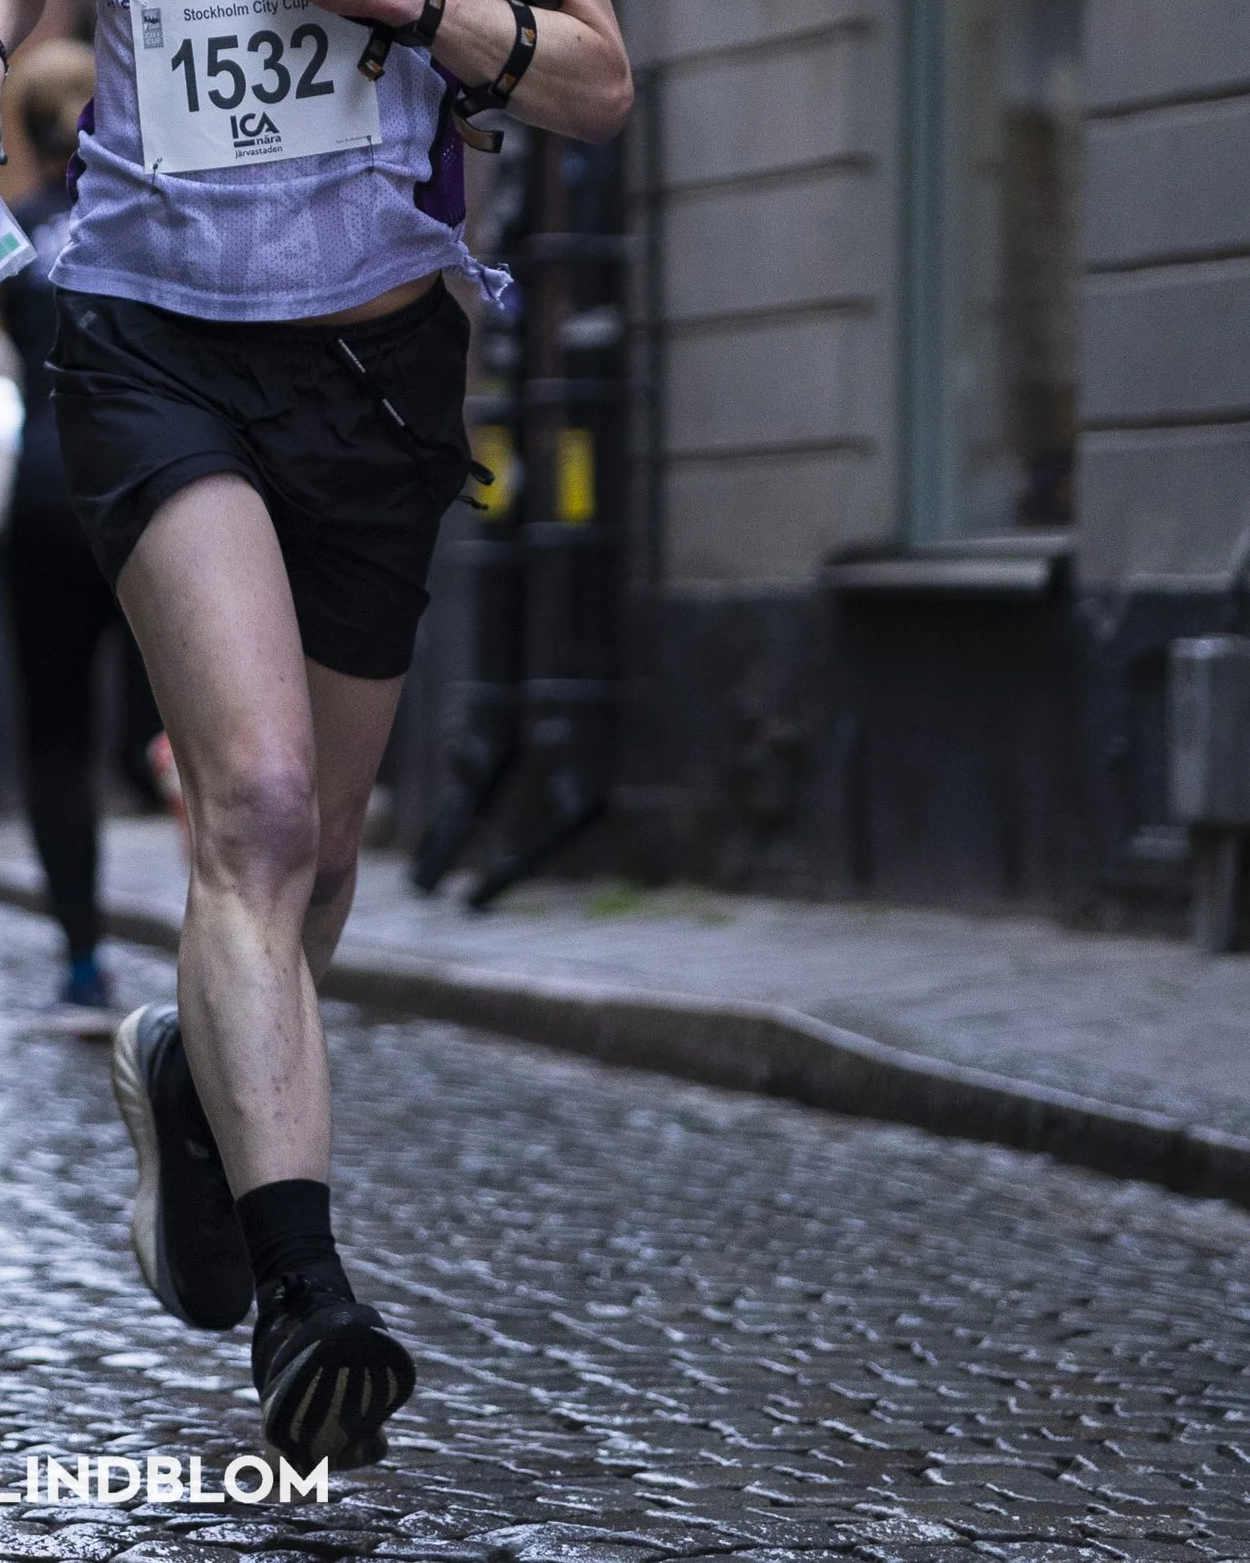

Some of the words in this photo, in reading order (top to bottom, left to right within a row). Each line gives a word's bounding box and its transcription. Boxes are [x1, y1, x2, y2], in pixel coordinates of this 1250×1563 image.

[183, 4, 249, 22] Stockholm
[252, 0, 279, 15] City
[170, 23, 335, 113] 1532
[230, 111, 280, 138] ICA
[256, 135, 282, 145] nära
[235, 145, 283, 158] Järvastaden
